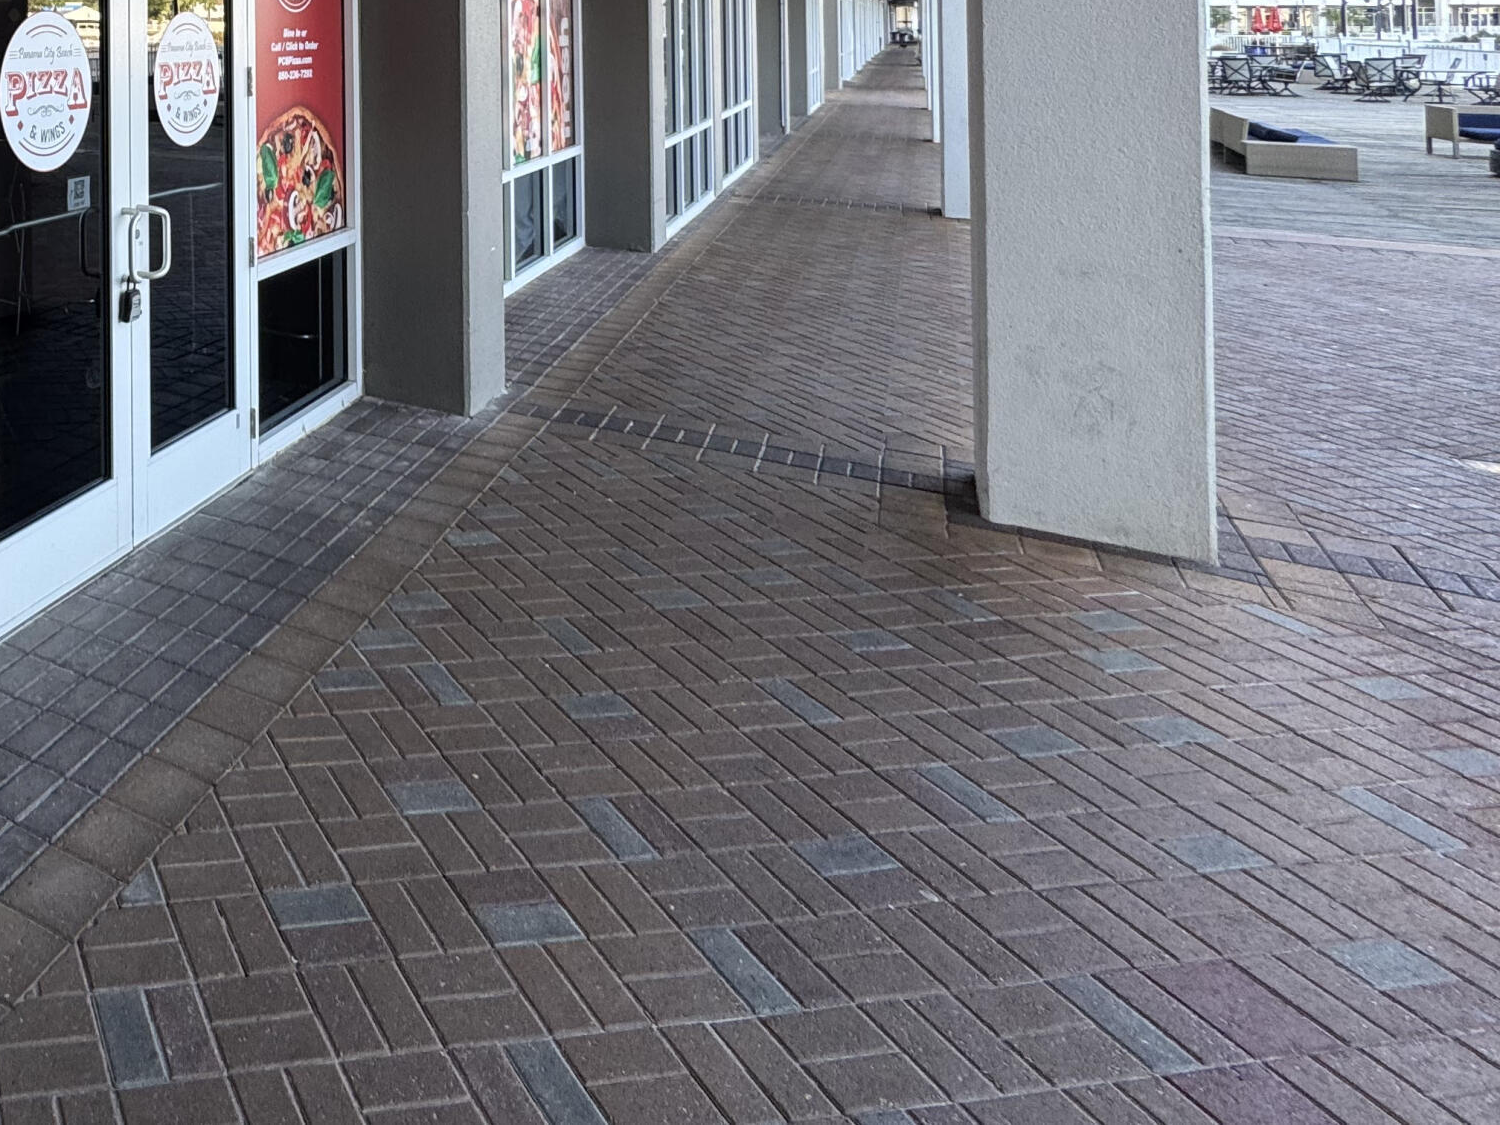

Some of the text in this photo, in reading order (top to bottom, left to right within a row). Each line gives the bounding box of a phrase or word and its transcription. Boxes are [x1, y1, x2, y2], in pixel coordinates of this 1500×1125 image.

[5, 67, 88, 117] PIZZA
[158, 59, 217, 100] PIZZA
[175, 103, 202, 122] & WINGS
[29, 121, 66, 143] & WINGS
